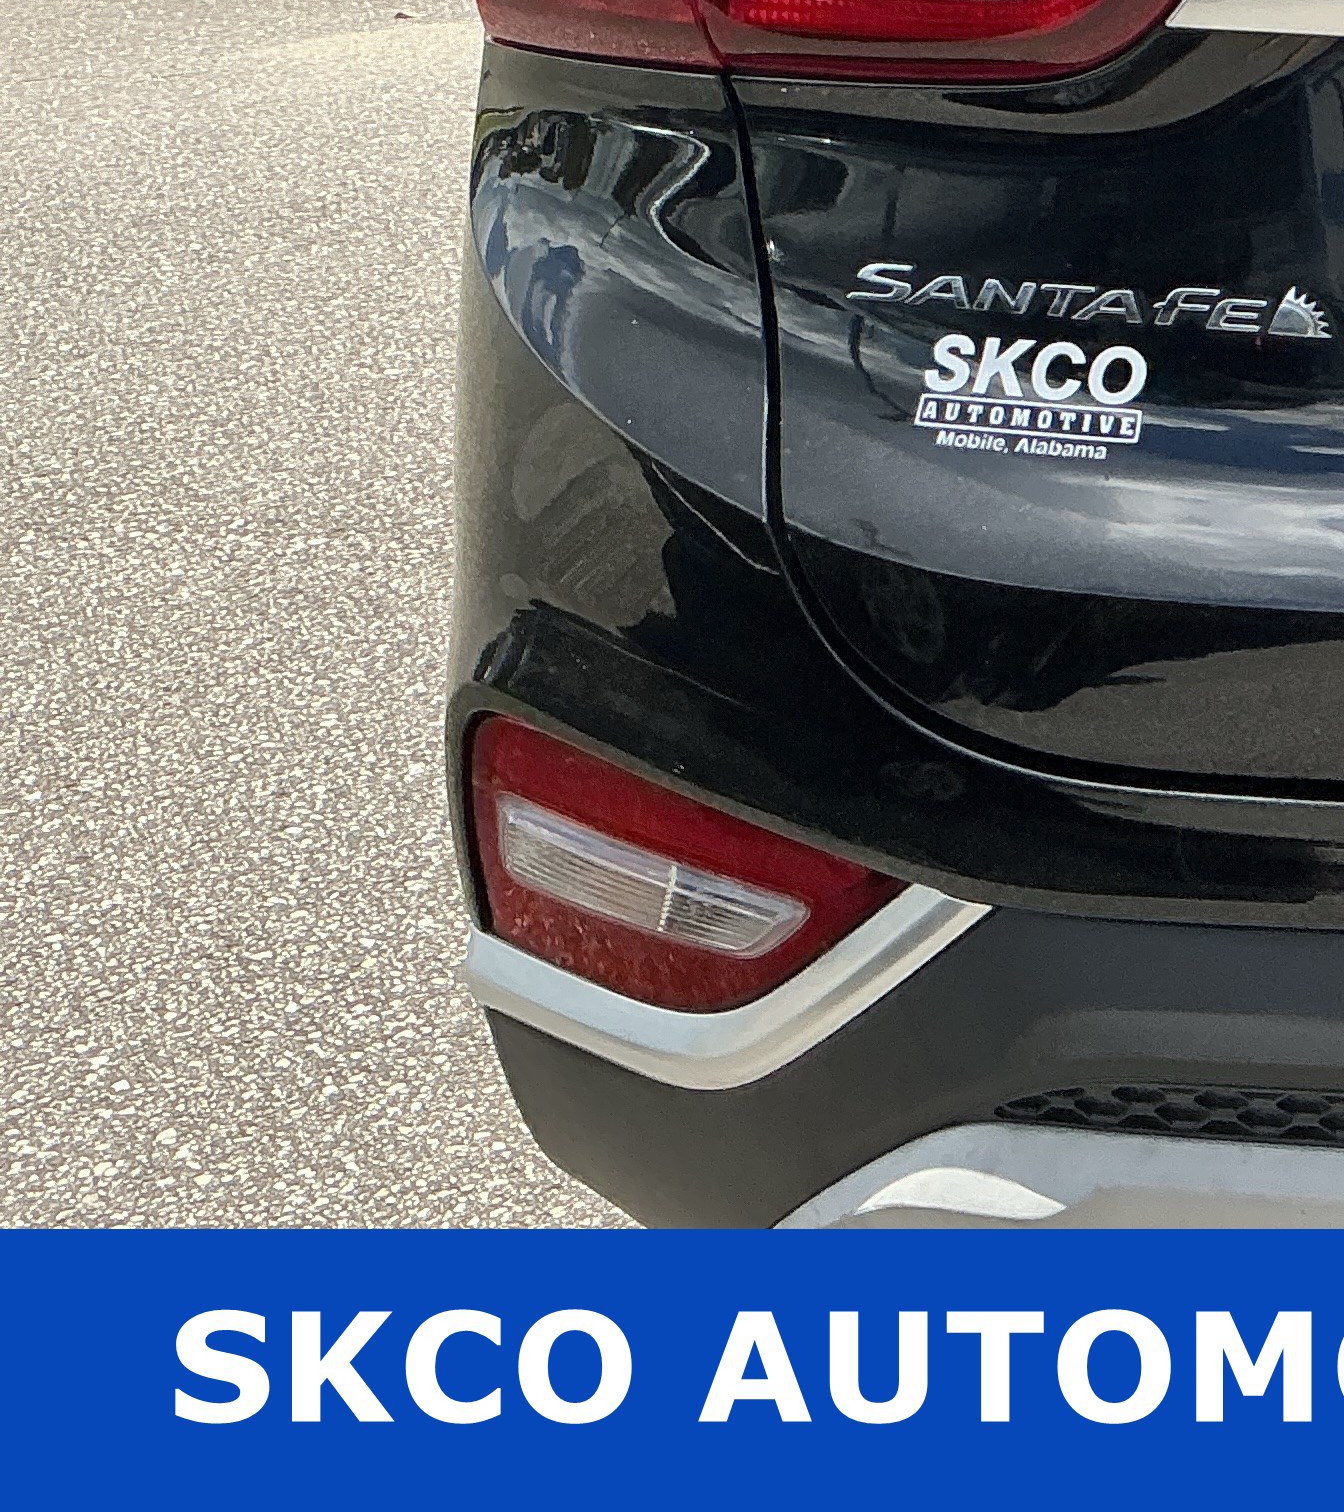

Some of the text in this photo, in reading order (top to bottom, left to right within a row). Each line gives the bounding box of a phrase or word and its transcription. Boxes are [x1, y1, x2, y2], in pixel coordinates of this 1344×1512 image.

[923, 333, 1149, 405] SKCO
[922, 401, 1136, 437] AUTOMOTIVE
[935, 430, 1108, 460] Mobile, Alabama
